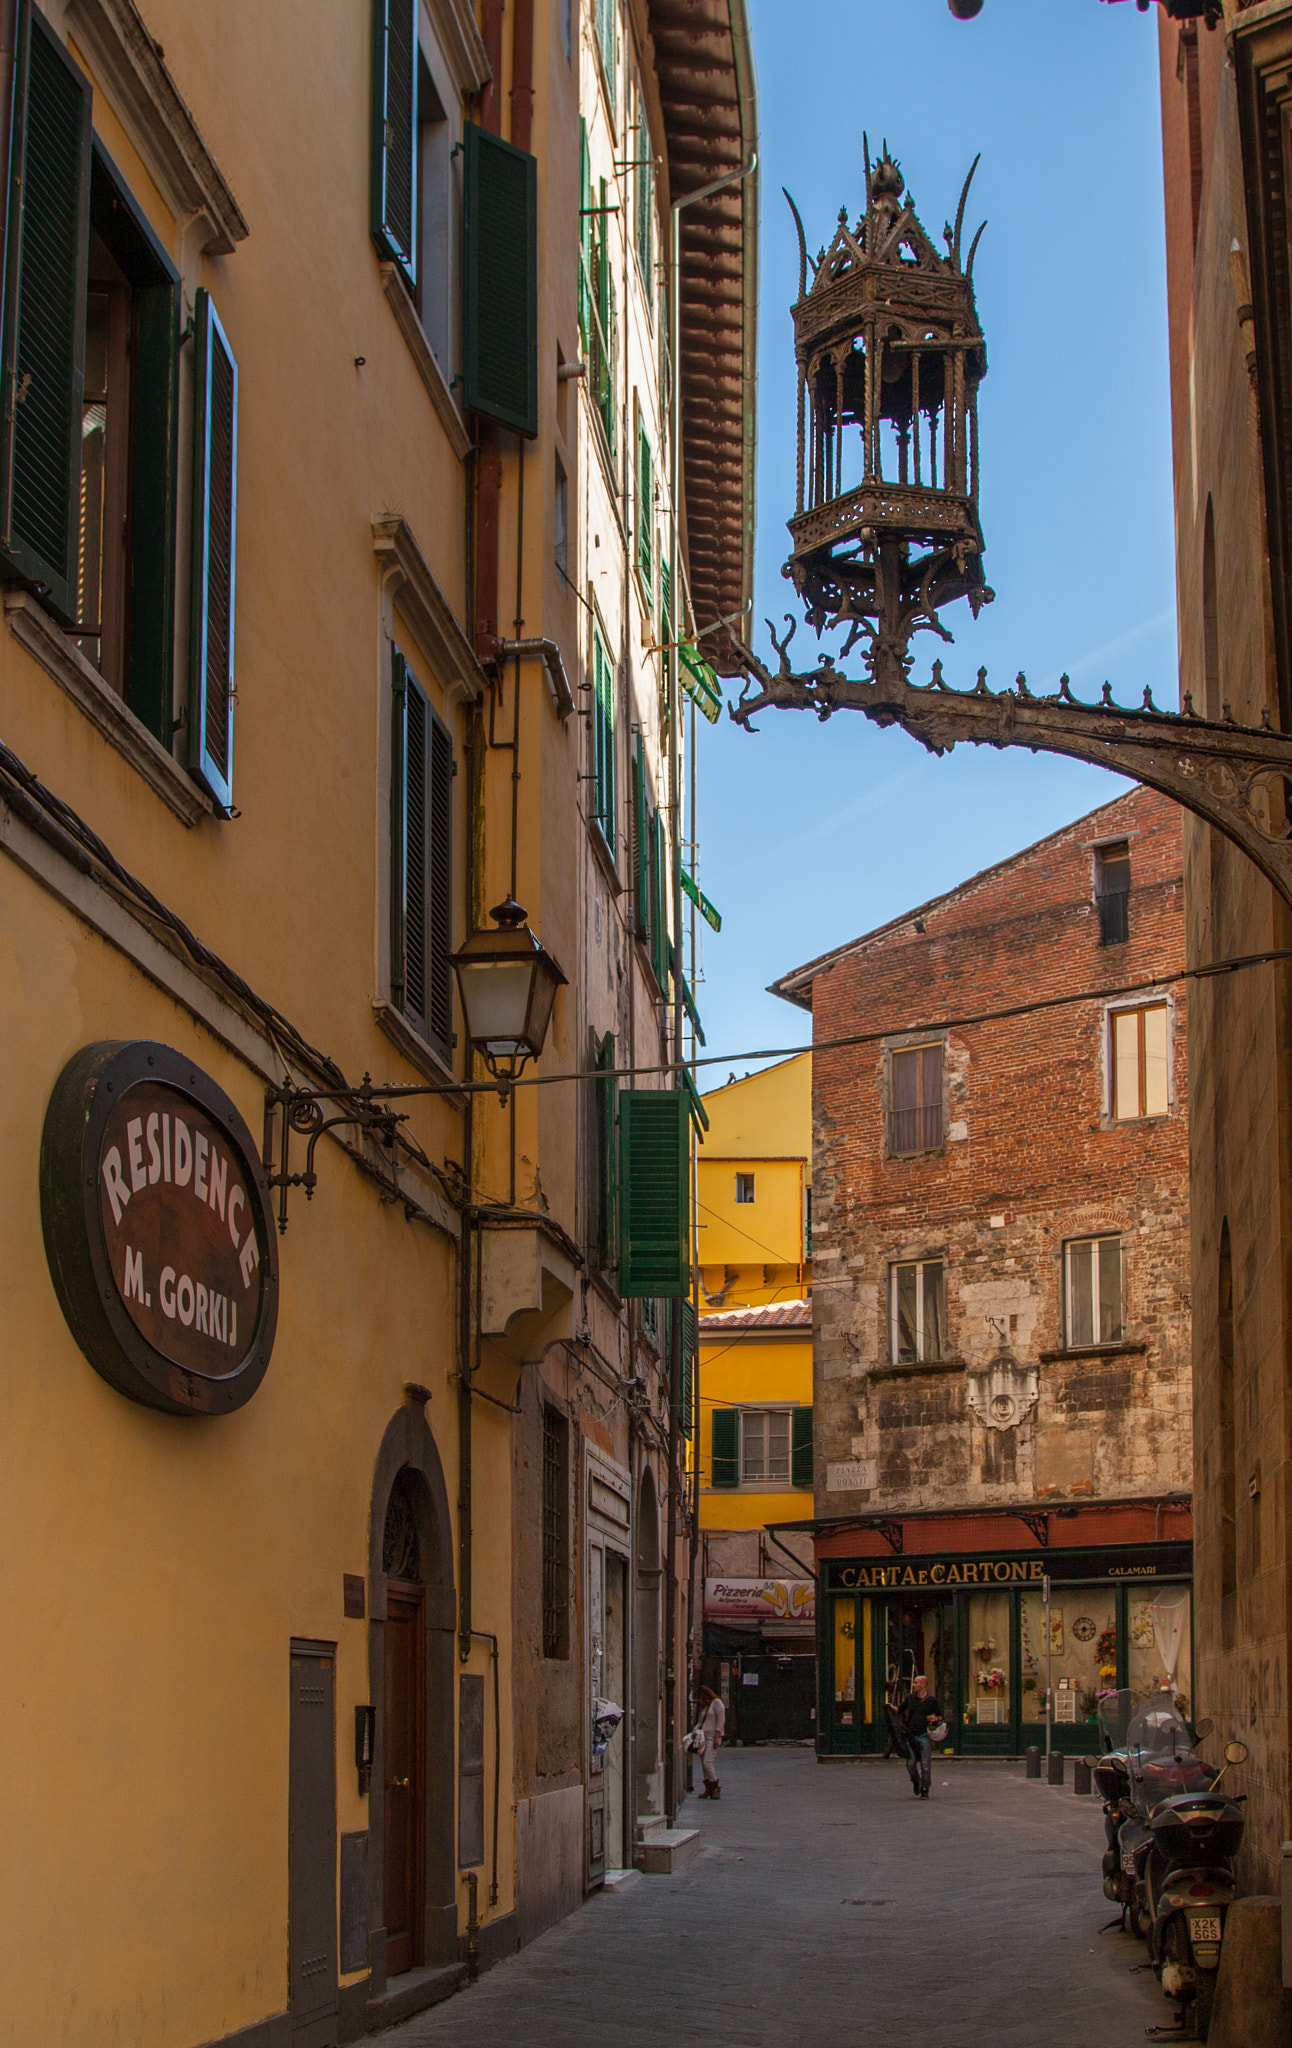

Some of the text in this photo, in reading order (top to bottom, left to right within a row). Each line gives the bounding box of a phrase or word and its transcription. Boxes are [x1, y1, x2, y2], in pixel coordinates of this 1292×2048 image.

[102, 1112, 260, 1289] RESIDENCE
[123, 1244, 238, 1347] M. GORKIJ
[836, 1465, 867, 1474] PIAZZA
[837, 1476, 867, 1486] DONATI
[841, 1566, 918, 1587] CARTA
[930, 1561, 1044, 1584] CARTONE
[1108, 1565, 1156, 1576] CALAMARI
[713, 1584, 764, 1598] Pizzeria
[1194, 1919, 1217, 1929] X2K
